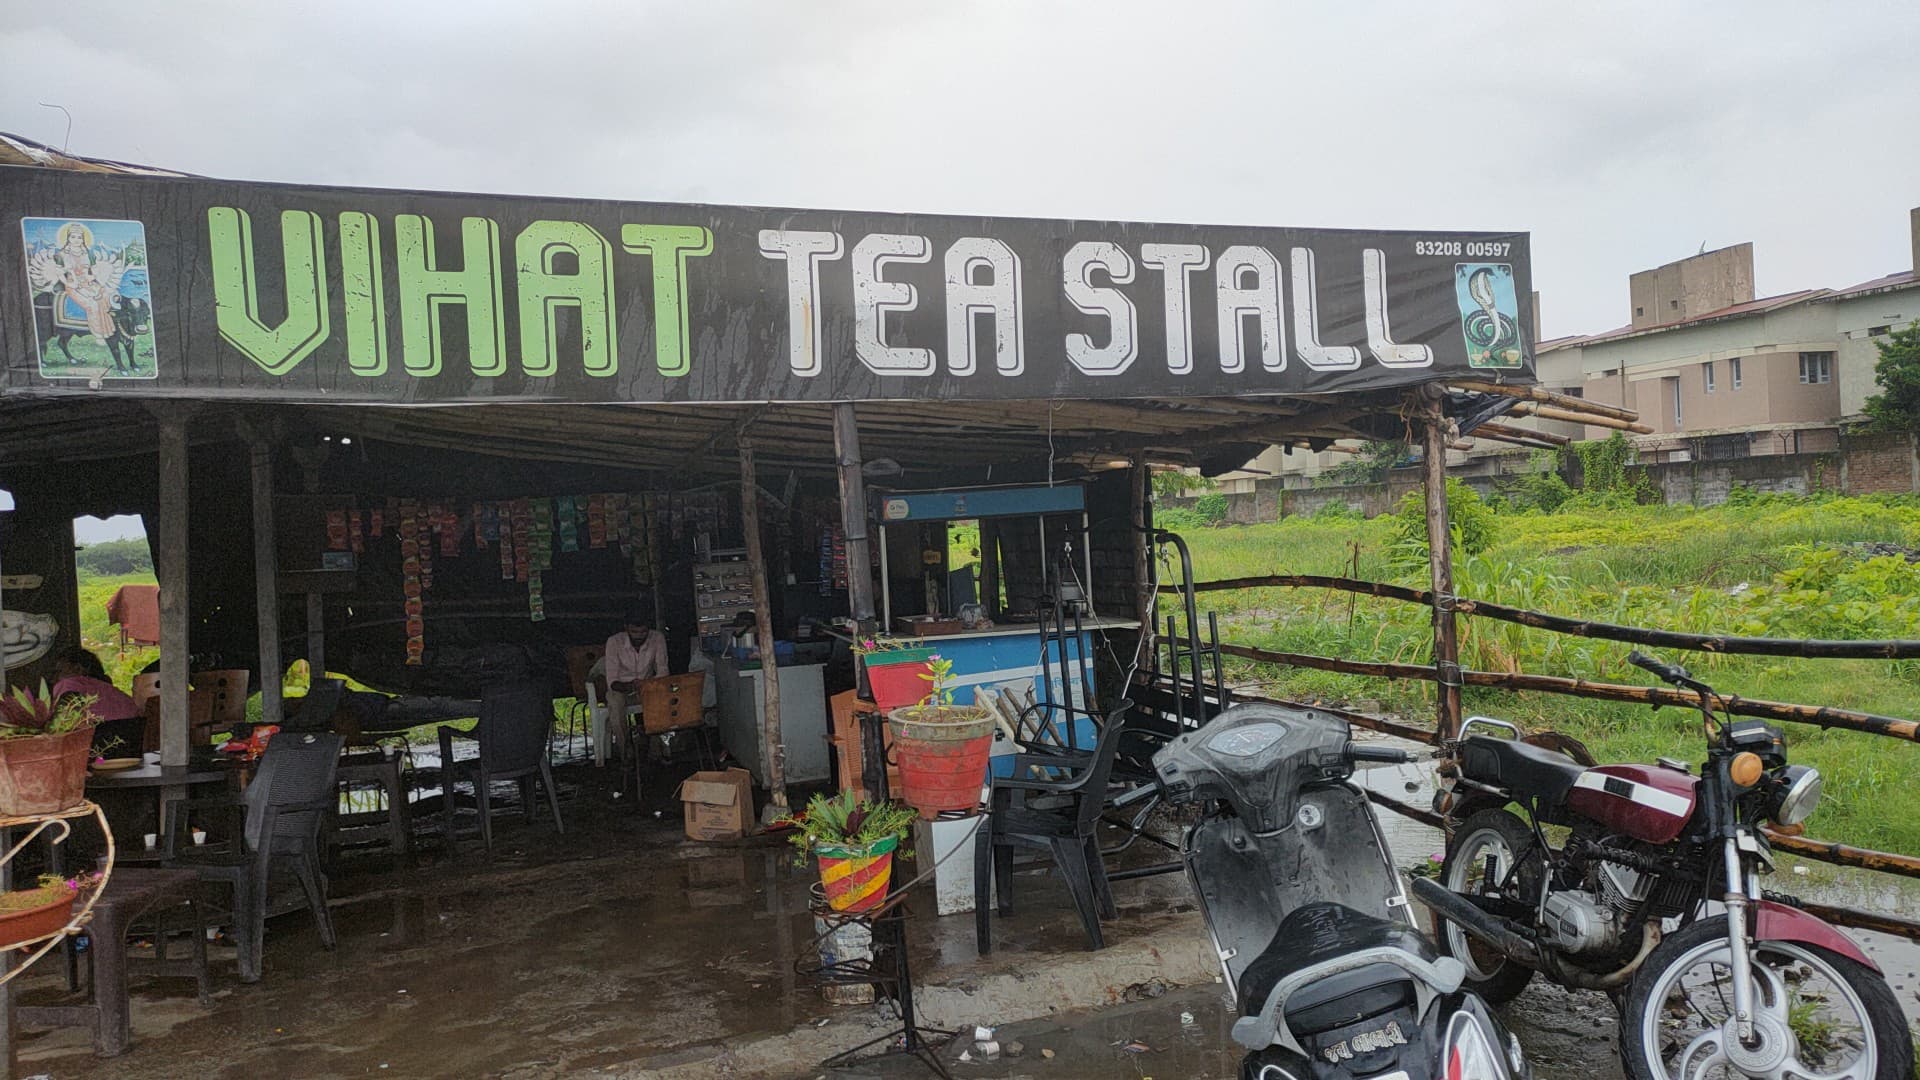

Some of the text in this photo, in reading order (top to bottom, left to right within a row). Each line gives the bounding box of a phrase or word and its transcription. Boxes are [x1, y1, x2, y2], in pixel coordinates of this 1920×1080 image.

[207, 206, 1433, 376] VIHAT TEA STALL
[1415, 241, 1511, 256] 83208 00597
